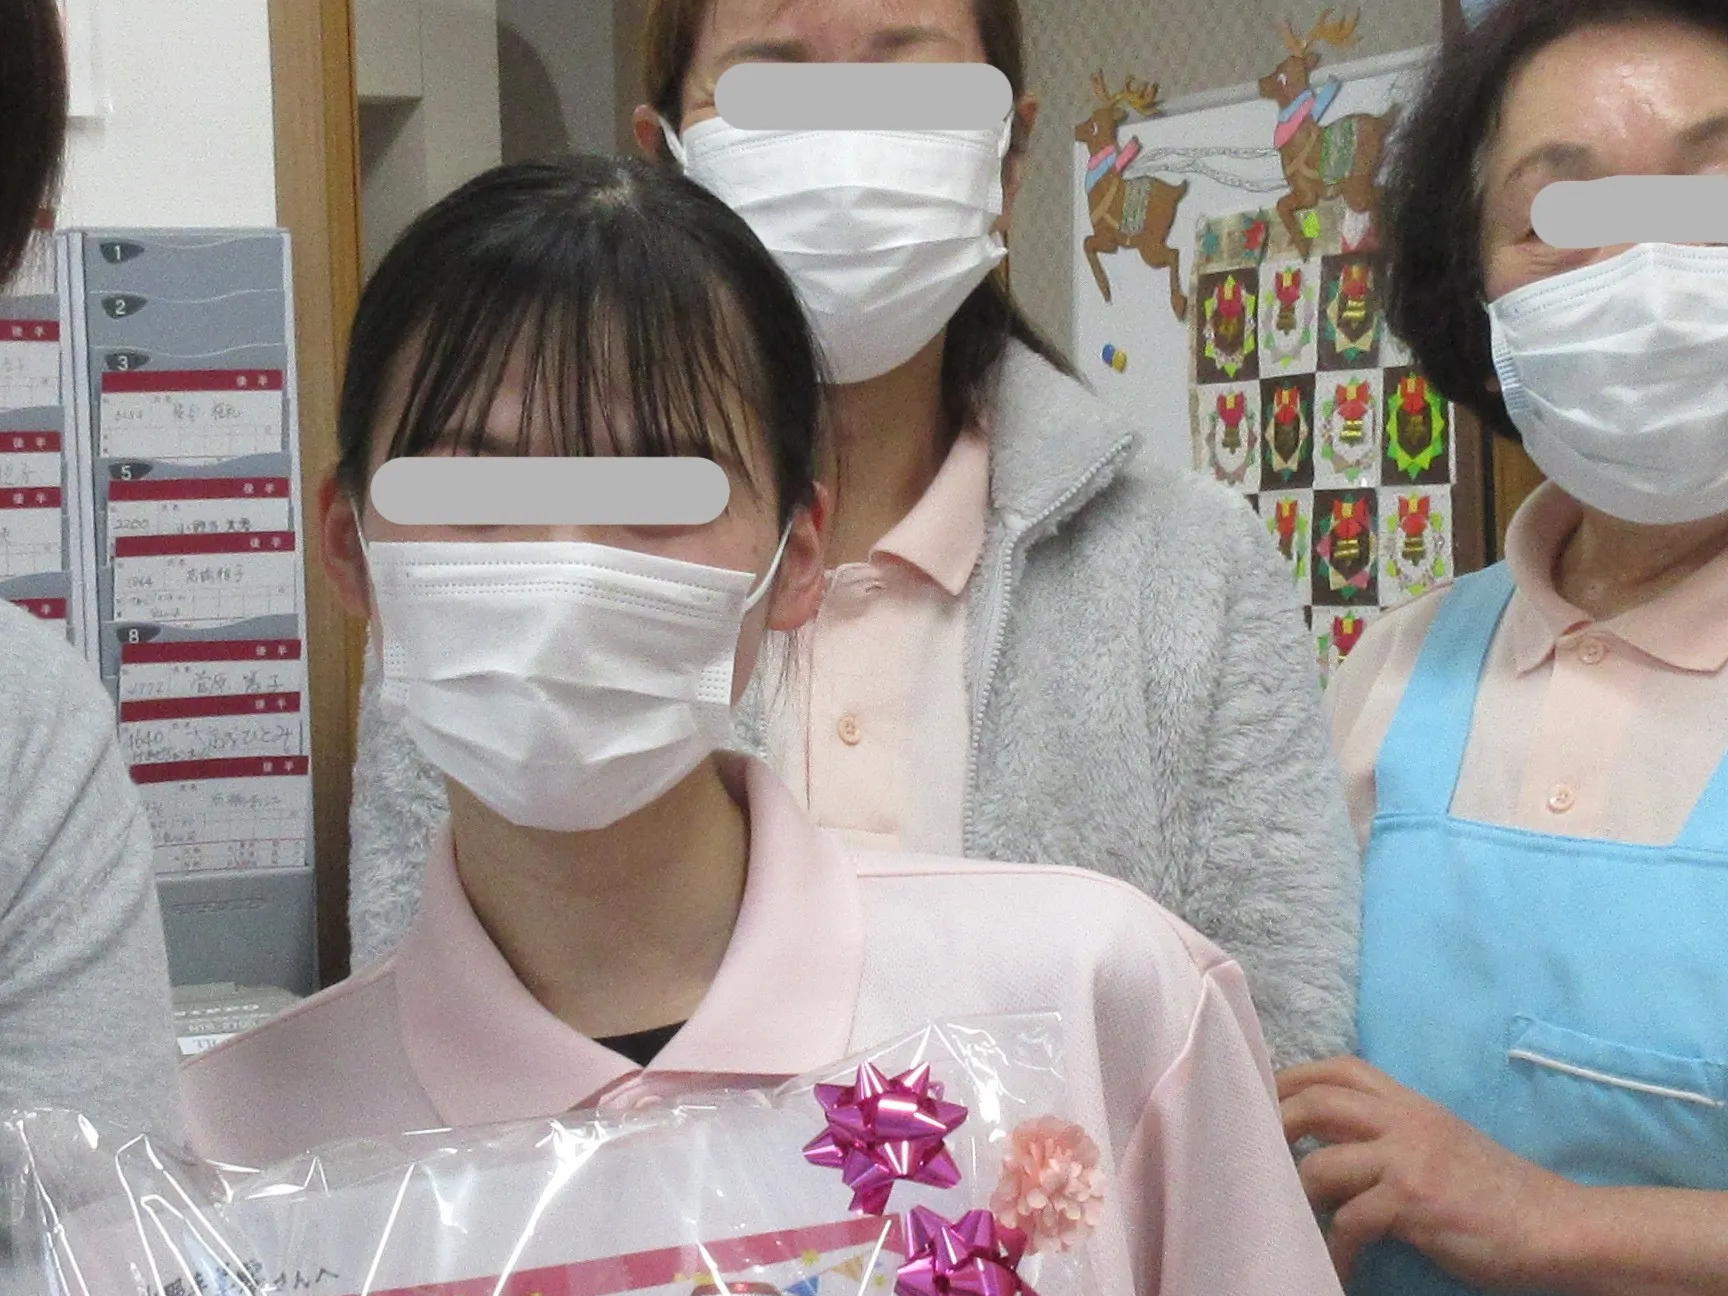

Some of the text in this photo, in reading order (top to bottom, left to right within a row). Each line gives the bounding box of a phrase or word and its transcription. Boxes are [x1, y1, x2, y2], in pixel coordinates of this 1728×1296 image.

[113, 245, 122, 260] 1
[115, 298, 126, 315] 2
[118, 355, 129, 371] 3
[121, 464, 132, 480] 5
[128, 629, 140, 644] 8
